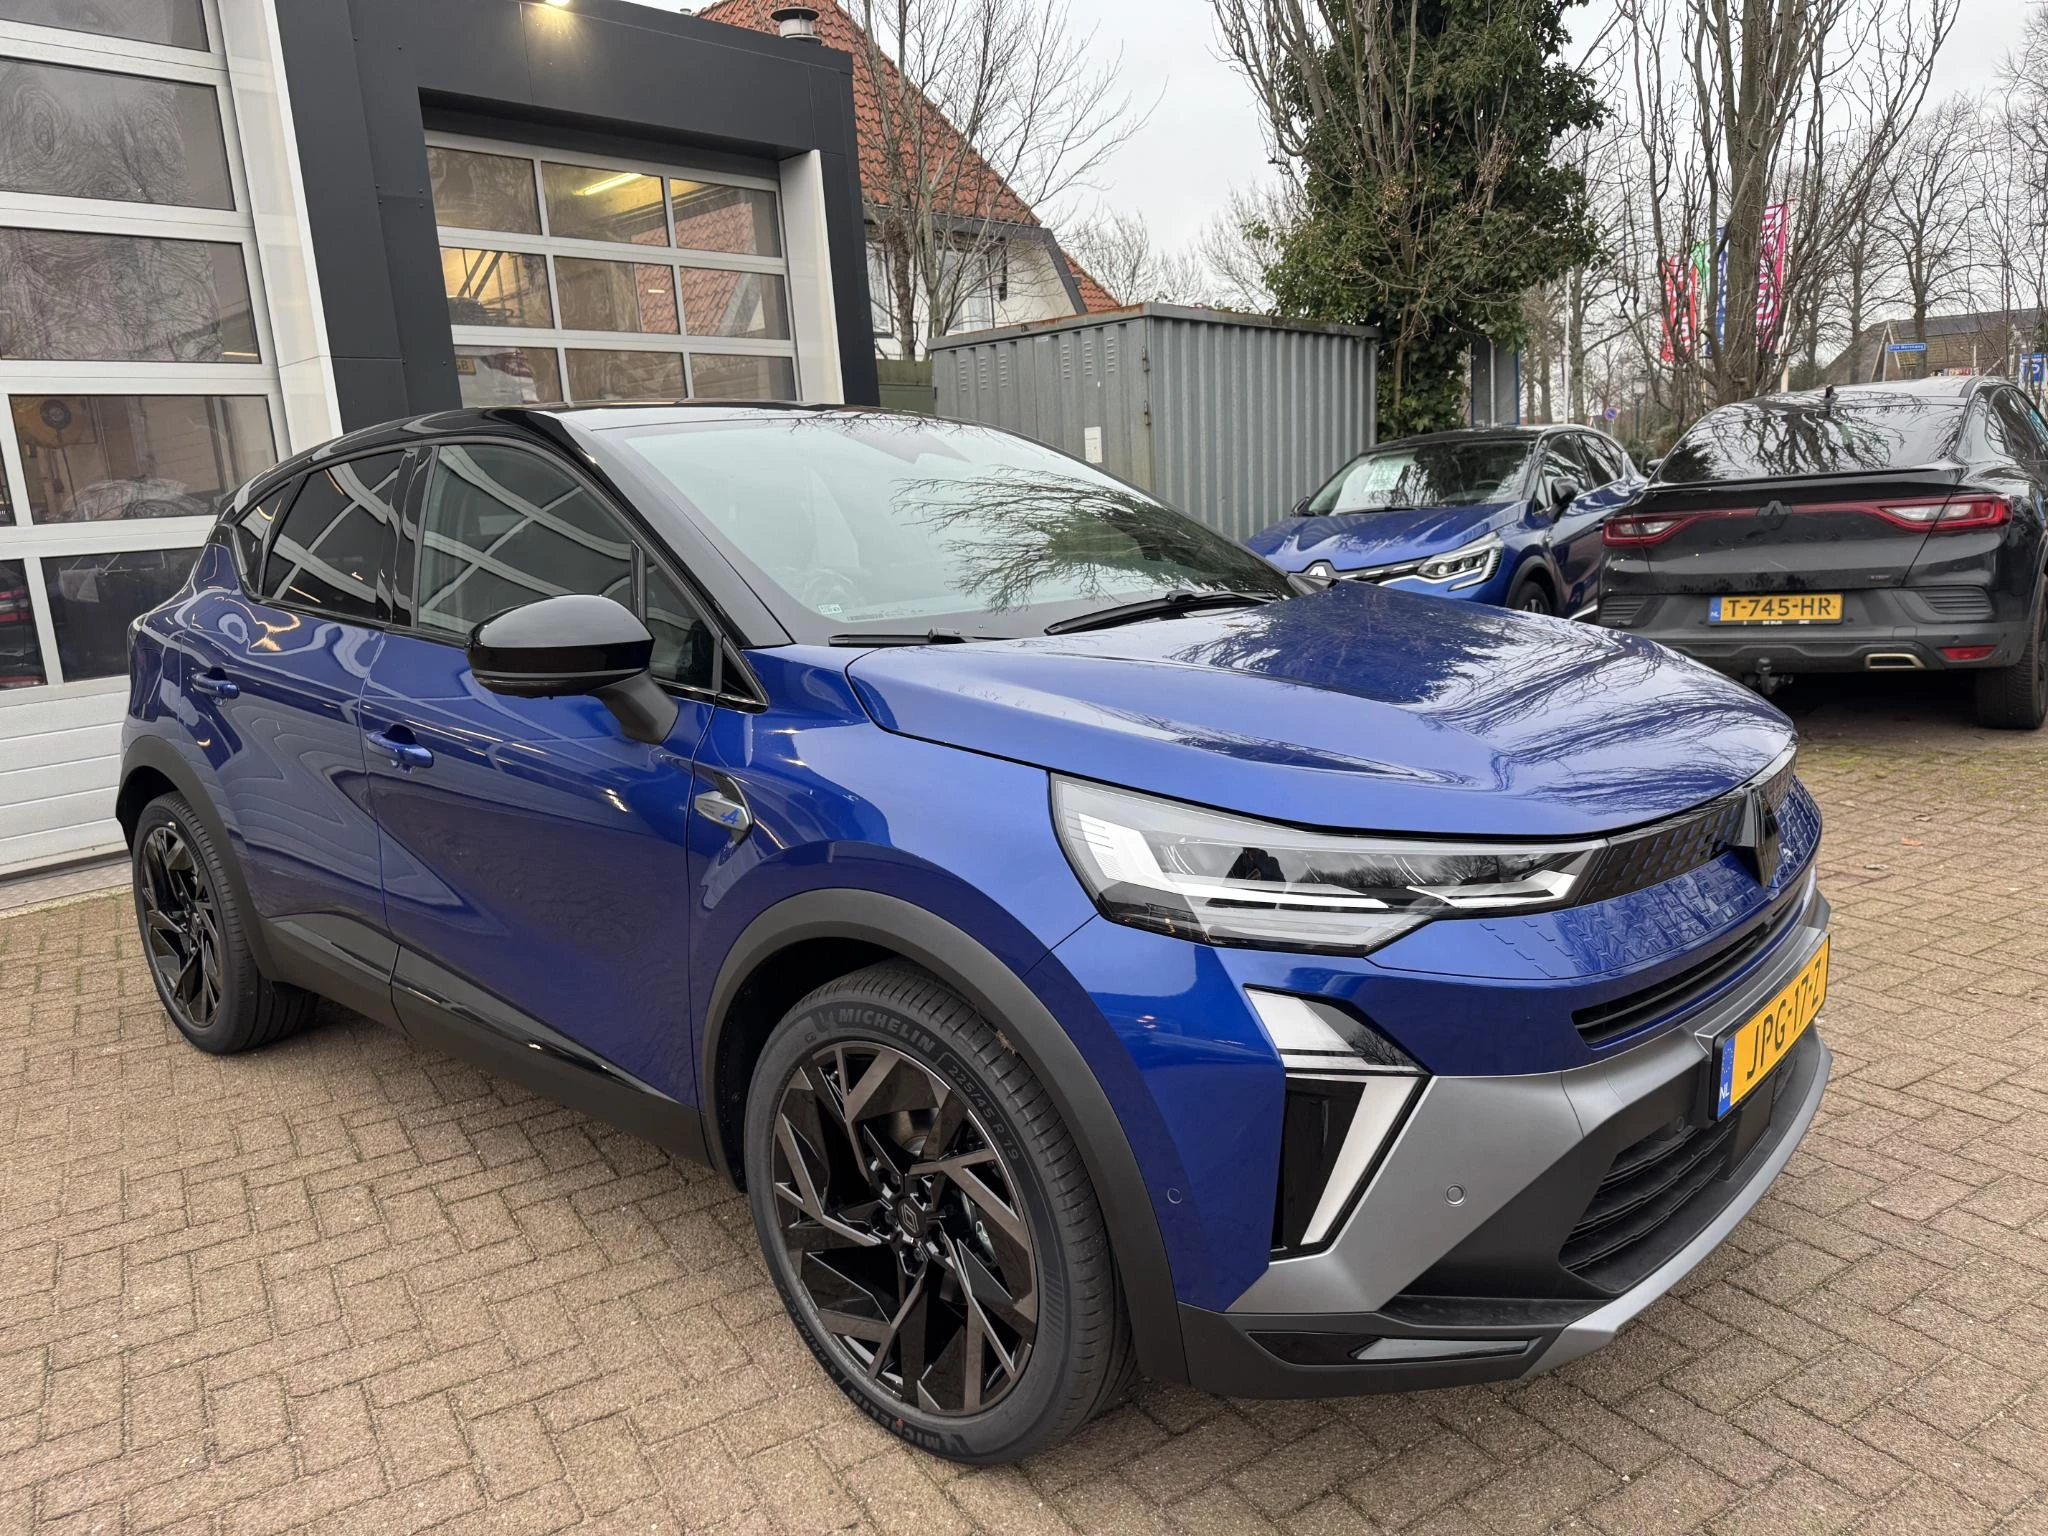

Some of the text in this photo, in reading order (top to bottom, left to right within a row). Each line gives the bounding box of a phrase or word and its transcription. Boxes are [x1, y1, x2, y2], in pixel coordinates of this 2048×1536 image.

[1727, 597, 1831, 617] T-745-HR
[838, 1007, 936, 1053] MICHELIN
[1746, 957, 1822, 1081] JPG-17-Z
[948, 1065, 995, 1119] 225/45
[1718, 1084, 1730, 1103] NL
[851, 1388, 941, 1447] MICHELIN
